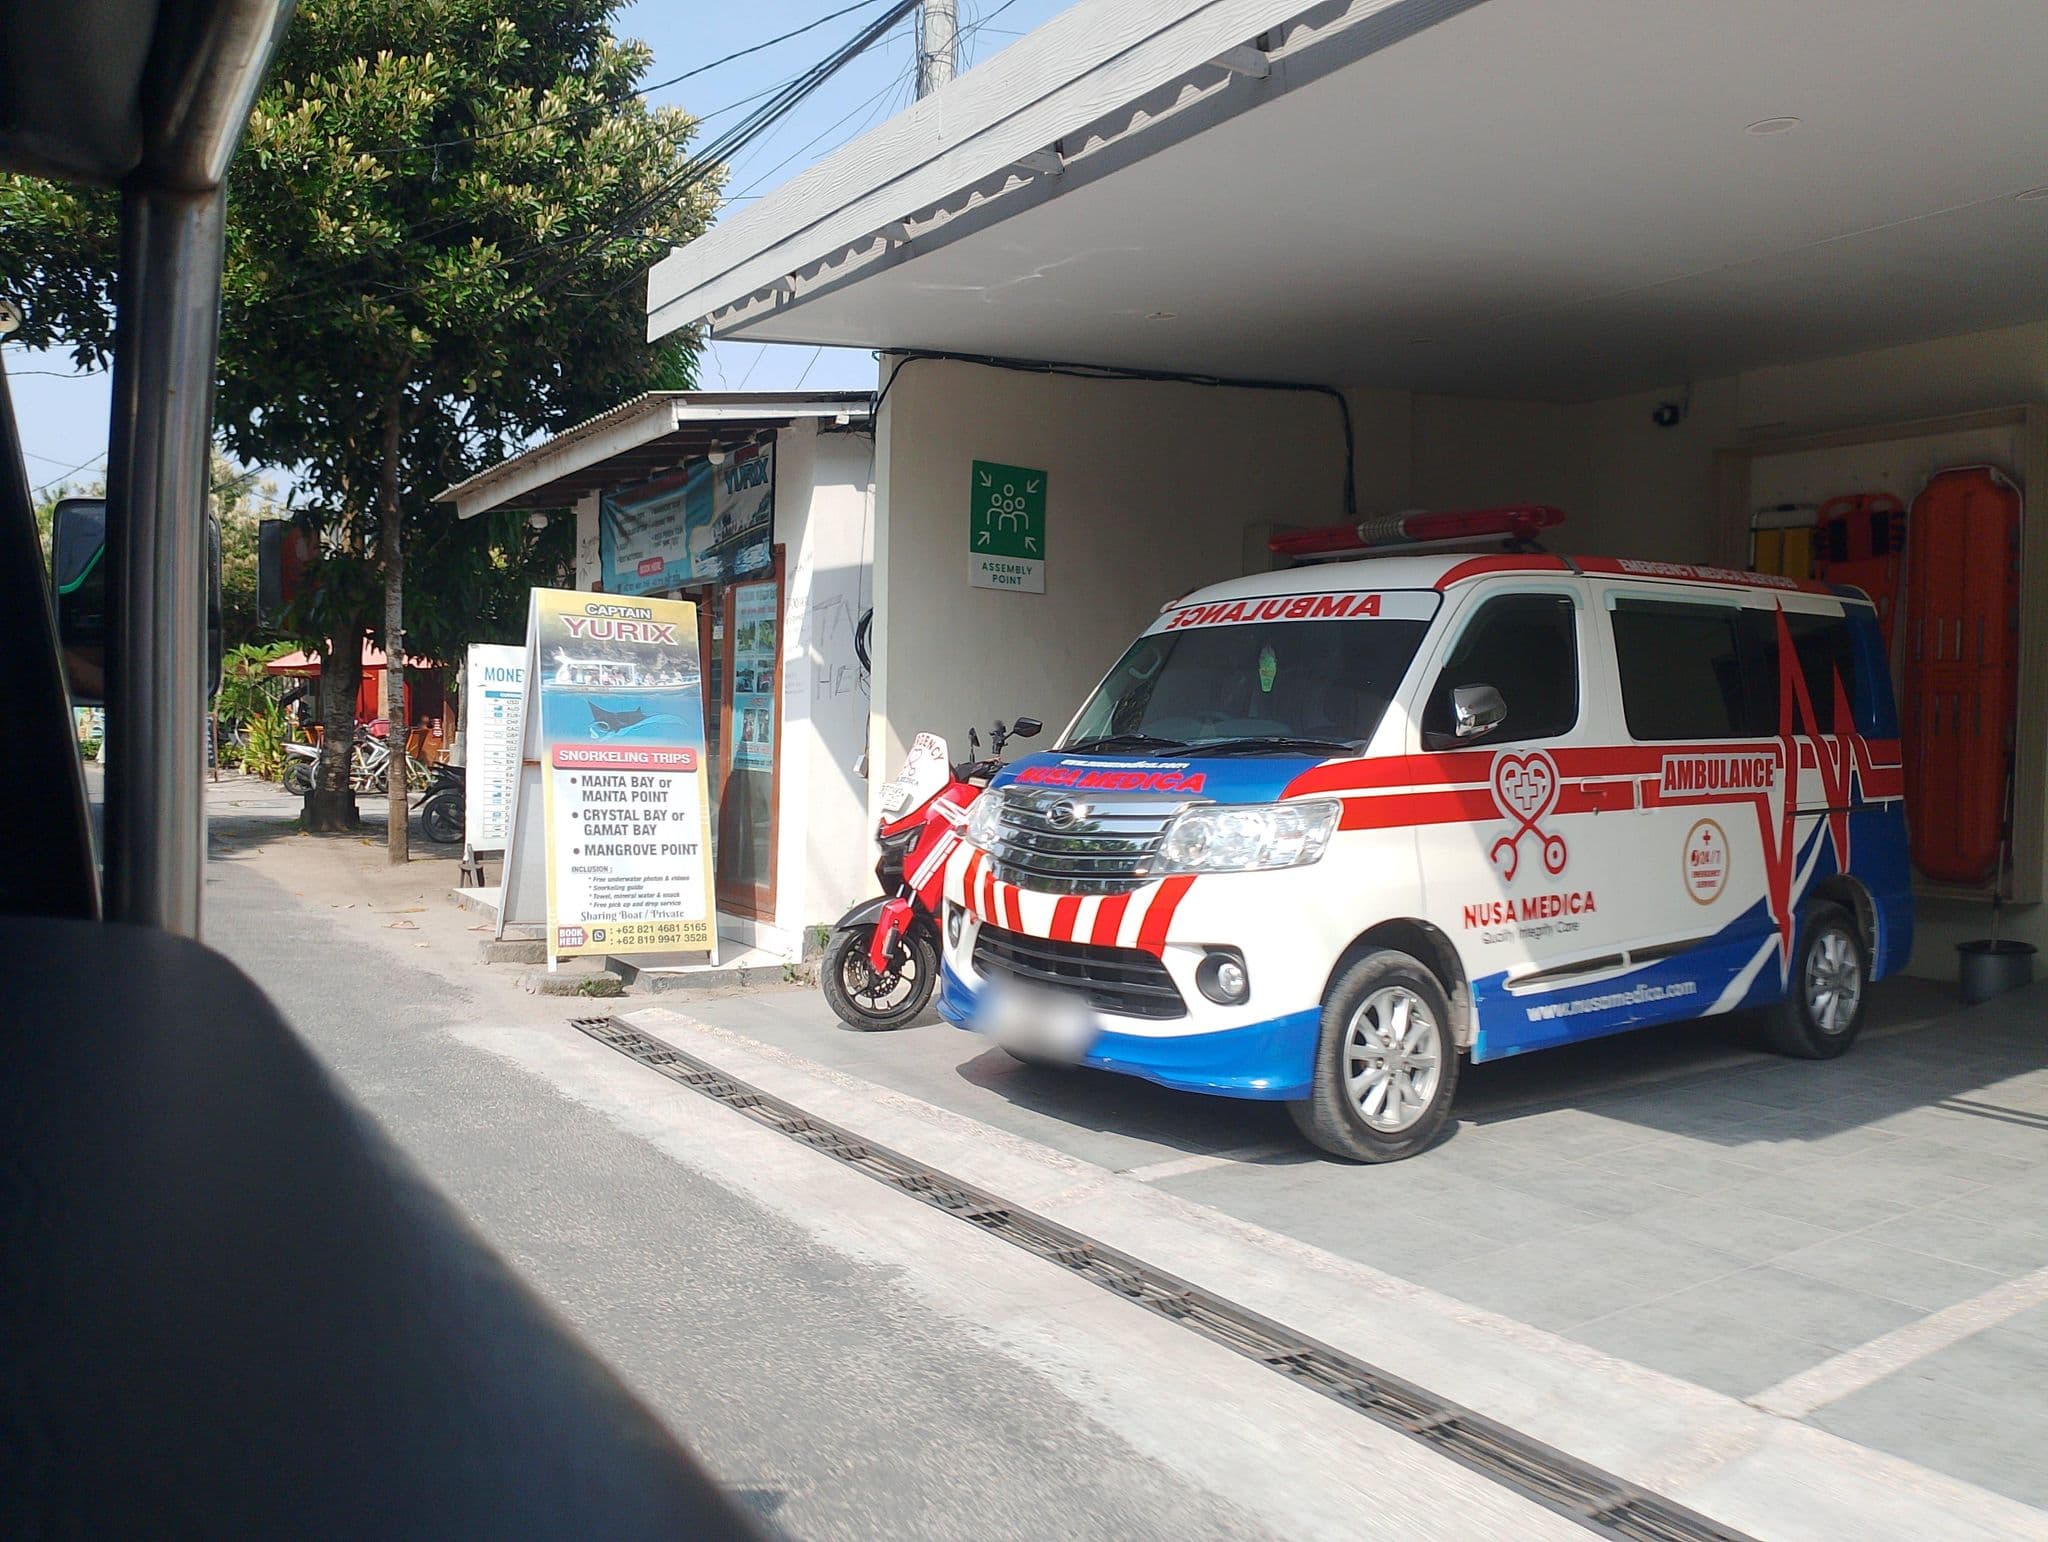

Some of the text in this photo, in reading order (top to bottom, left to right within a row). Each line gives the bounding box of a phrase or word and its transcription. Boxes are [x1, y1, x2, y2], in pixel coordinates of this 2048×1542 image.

[982, 562, 1033, 576] ASSEMBLY
[992, 574, 1022, 585] POINT
[586, 603, 652, 619] CAPTAIN
[560, 615, 679, 646] YURIX
[559, 750, 691, 764] SNORKELING TRIPS
[1015, 766, 1207, 793] NUSA MEDICA
[1664, 758, 1774, 791] AMBULANCE
[581, 775, 672, 788] MANTA BAY or
[582, 790, 669, 803] MANTA POINT
[583, 809, 685, 821] CRYSTAL BAY or
[584, 824, 657, 836] GAMAT BAY
[584, 843, 698, 856] MANGROVE POINT
[643, 875, 664, 883] photos
[627, 884, 644, 892] guide
[608, 901, 622, 909] pick
[644, 900, 659, 908] drop
[1463, 890, 1596, 930] NUSA MEDICA
[581, 911, 617, 922] Sharing
[619, 910, 642, 920] Boat
[650, 909, 685, 919] Private
[559, 929, 583, 937] BOOK
[616, 926, 635, 934] +62
[637, 924, 654, 934] 821
[657, 923, 680, 933] 4681
[683, 923, 707, 932] 5165
[1481, 920, 1580, 945] Quality Integrity Care
[559, 937, 583, 946] HERE
[616, 936, 635, 945] +62
[637, 935, 655, 944] 819
[658, 934, 681, 943] 9947
[684, 933, 708, 942] 3528
[1526, 981, 1697, 1022] www.nusamedica.com
